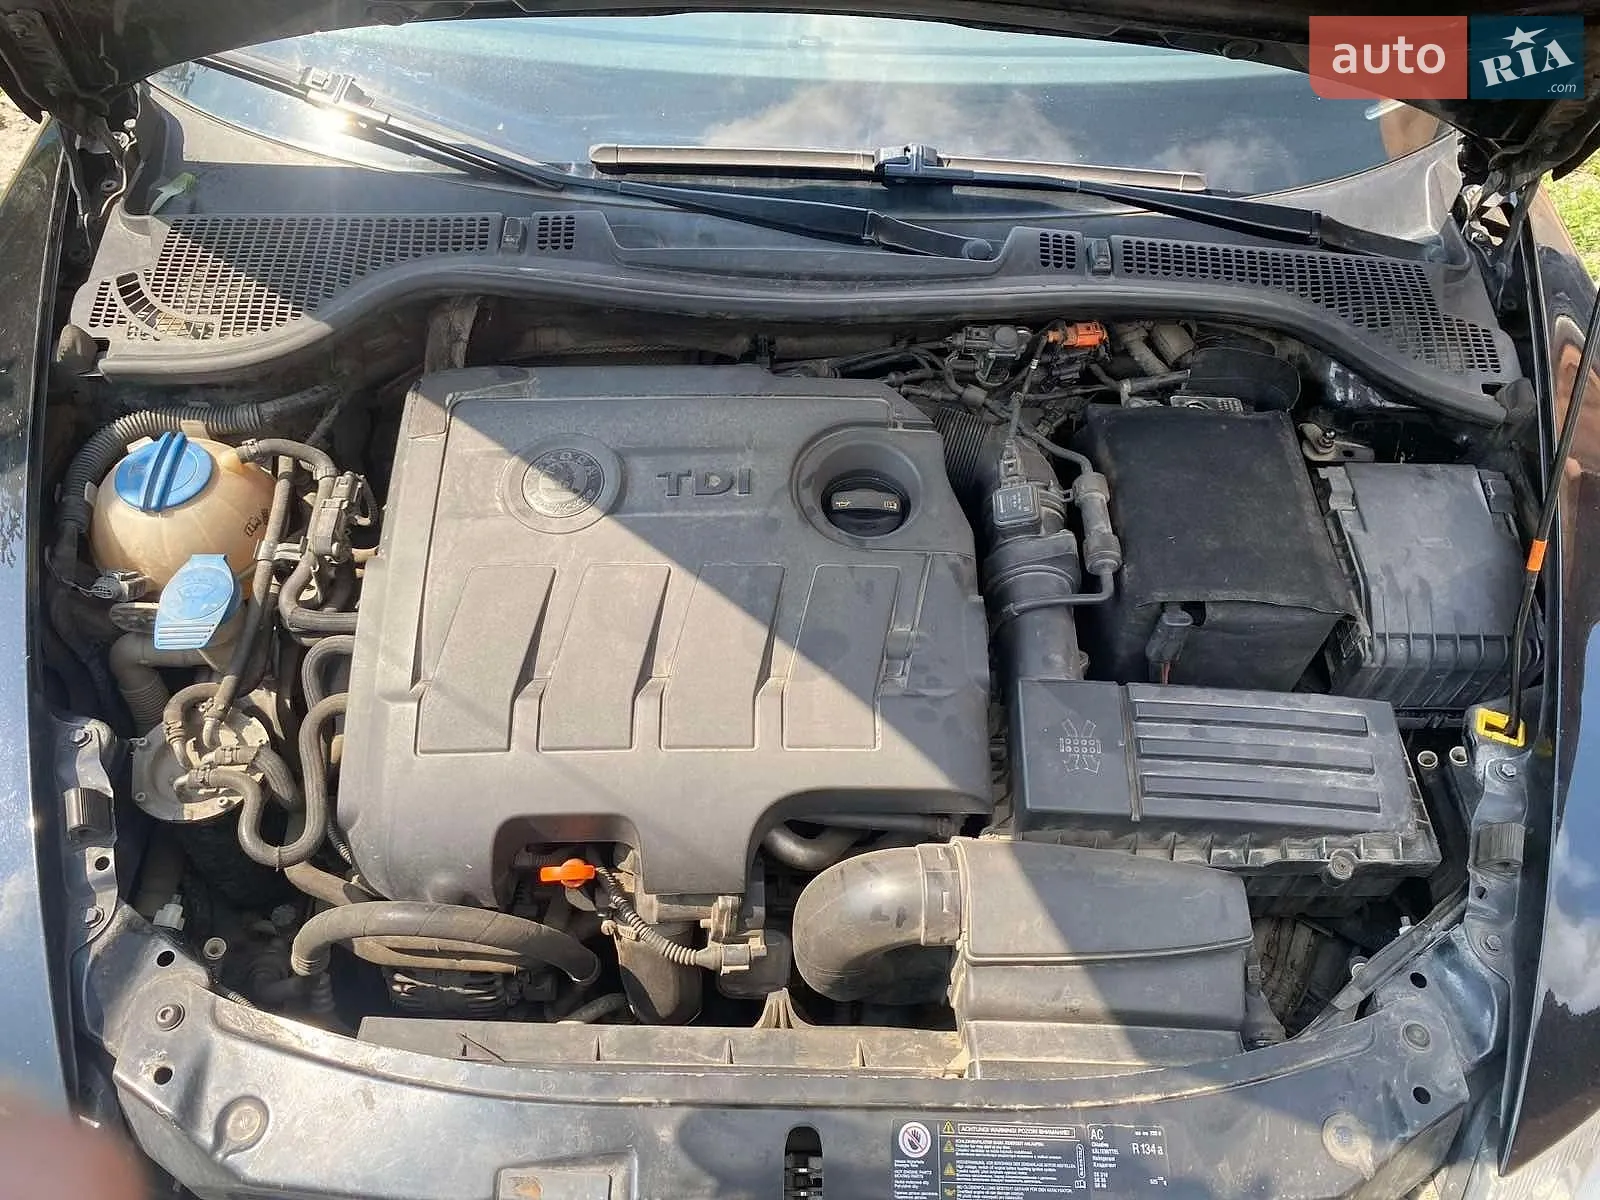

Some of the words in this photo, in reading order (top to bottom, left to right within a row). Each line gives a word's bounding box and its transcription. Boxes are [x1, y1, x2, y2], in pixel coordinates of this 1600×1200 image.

[656, 468, 752, 497] TDI
[1090, 1129, 1104, 1141] AC
[1132, 1143, 1140, 1155] R
[1141, 1143, 1156, 1155] 134
